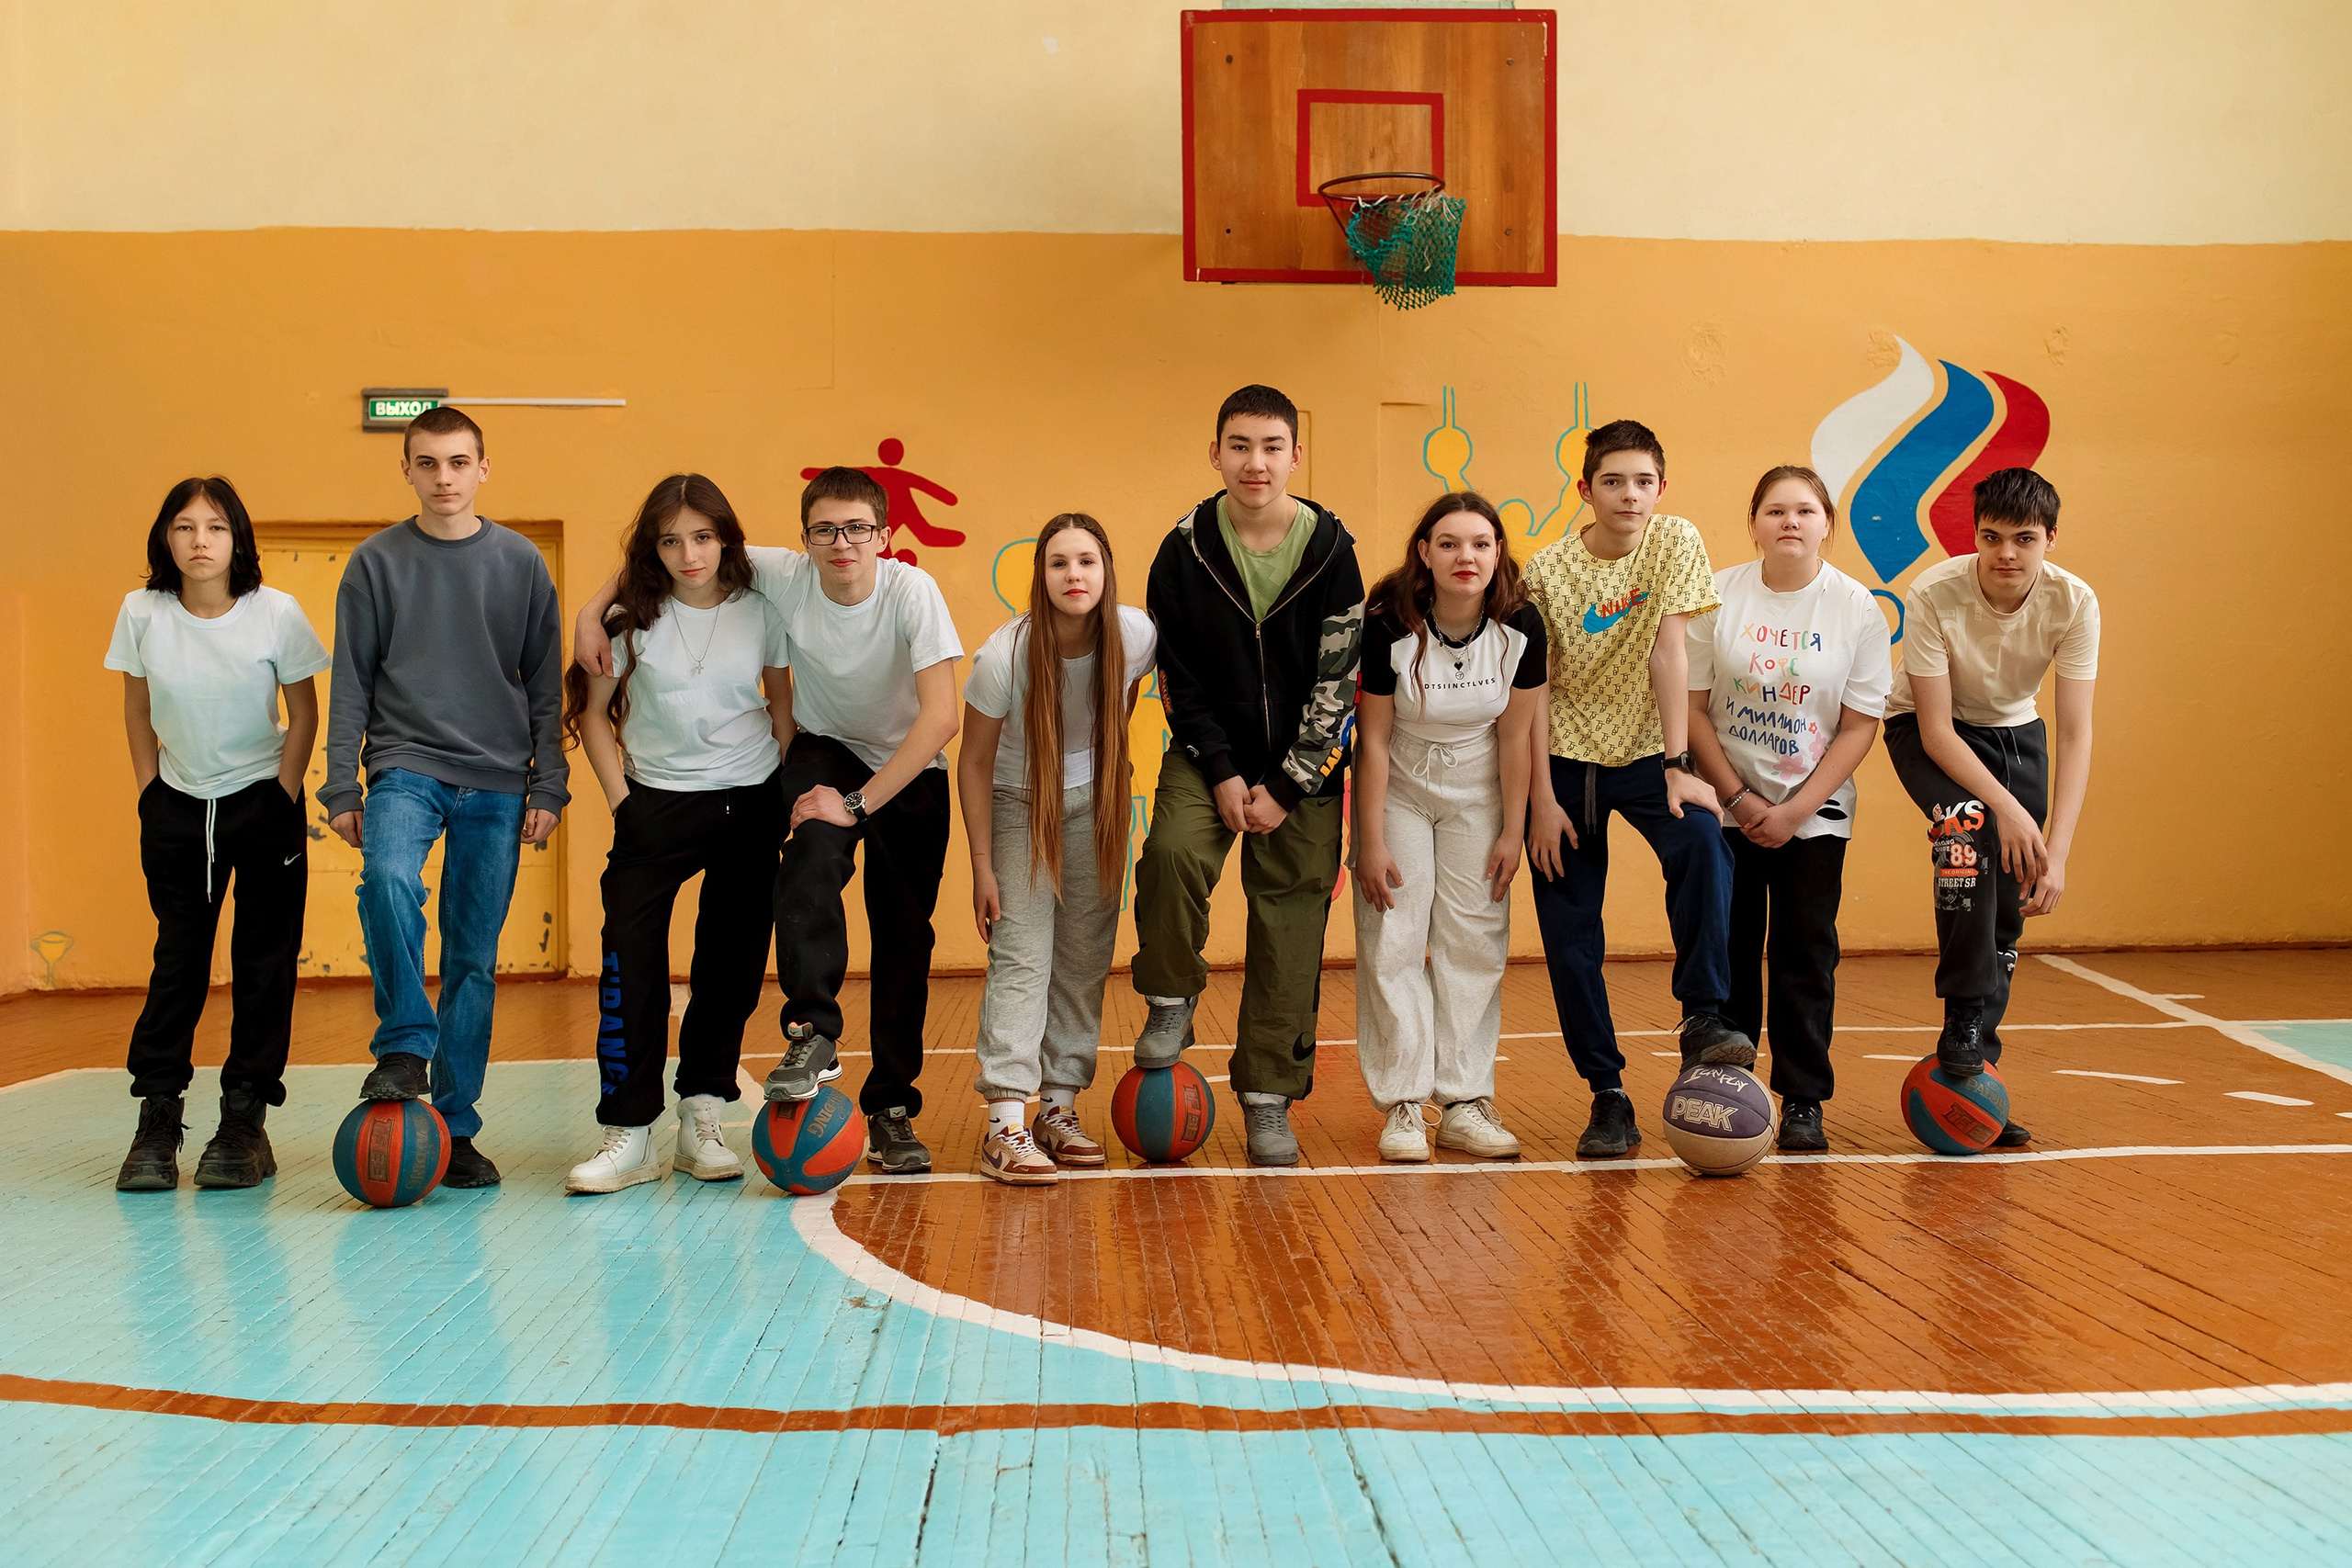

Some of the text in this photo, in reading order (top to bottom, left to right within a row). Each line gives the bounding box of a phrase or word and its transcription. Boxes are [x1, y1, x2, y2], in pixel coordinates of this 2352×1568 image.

[1601, 588, 1644, 619] NIKE
[1739, 623, 1821, 651] ХОЧЕТСЯ
[1424, 678, 1496, 690] DTSIINCTLVES
[1733, 677, 1811, 705] КИНДЕР
[1725, 696, 1806, 734] И МИЛЛИОН
[1728, 725, 1800, 756] ДОЛЛАРОВ
[1951, 843, 1977, 865] 89
[1938, 877, 1964, 888] STREET
[1670, 1095, 1739, 1132] PEAK
